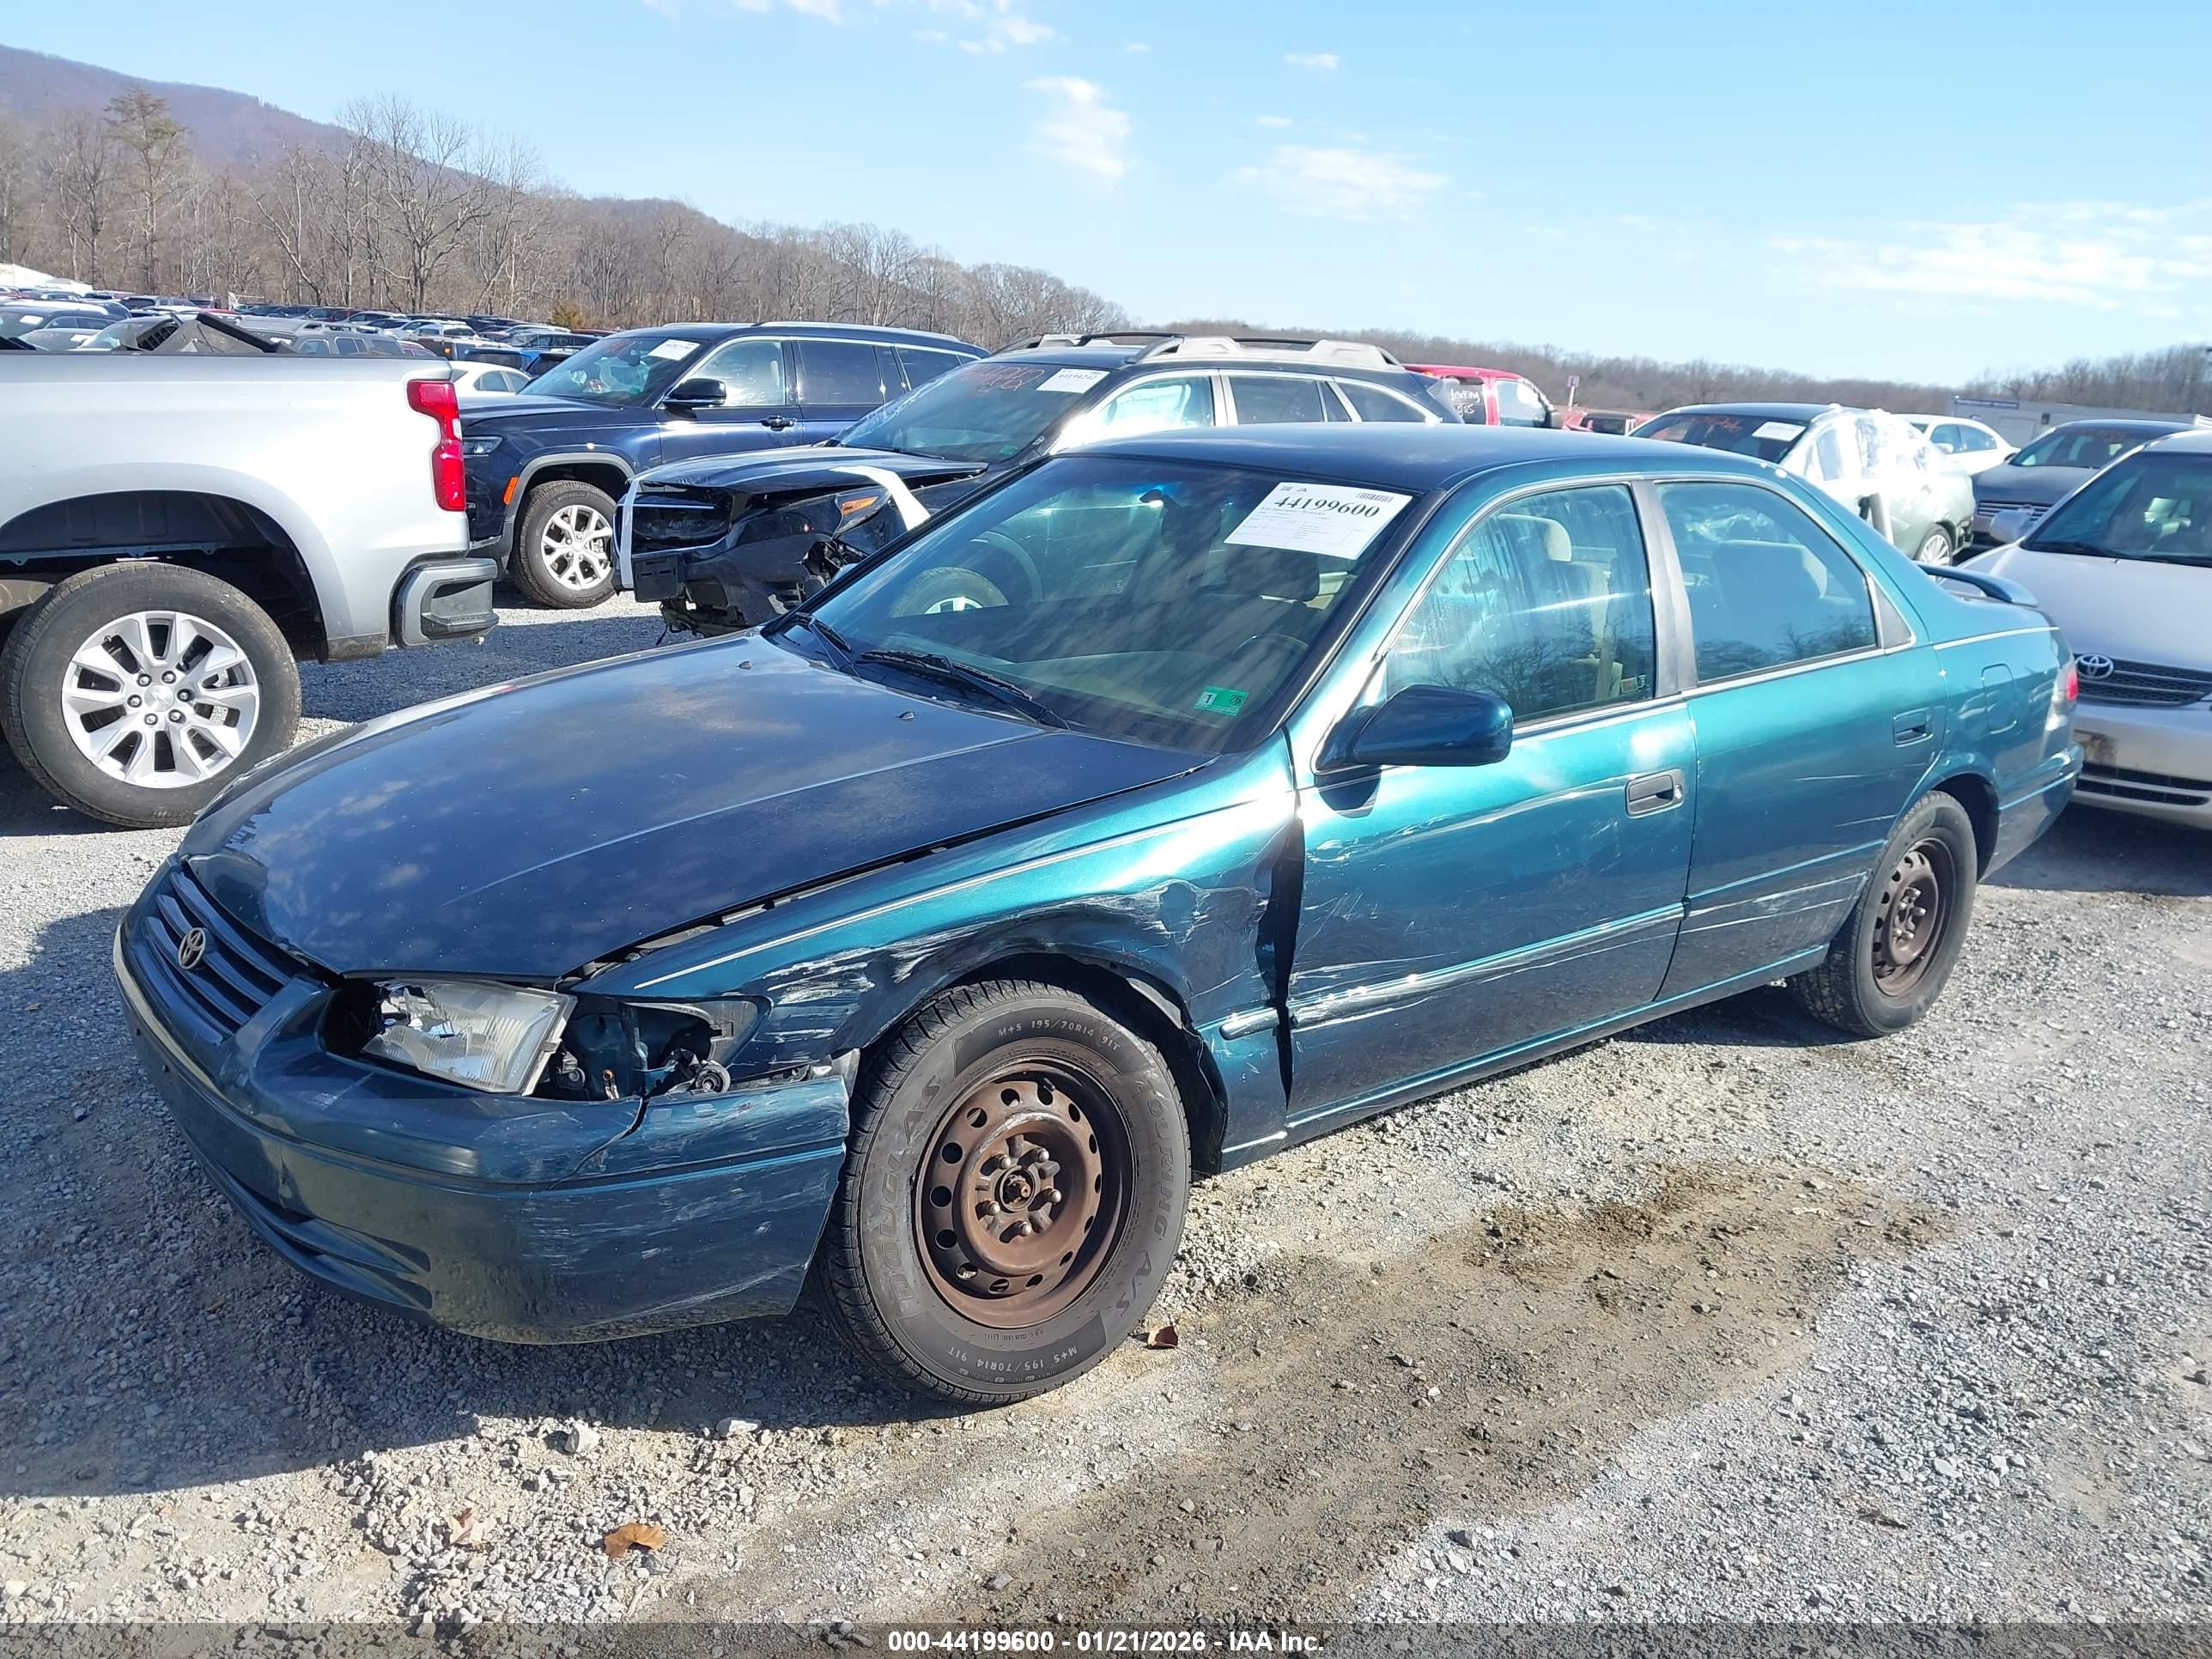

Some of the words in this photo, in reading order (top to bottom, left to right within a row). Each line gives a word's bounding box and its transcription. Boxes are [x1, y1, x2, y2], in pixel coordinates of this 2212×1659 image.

[1274, 496, 1380, 517] 44199600
[998, 1023, 1022, 1037] M+S
[1031, 1018, 1094, 1036] 195/70R14
[1102, 1036, 1121, 1051] 91T
[947, 1346, 968, 1362] 91T
[1054, 1346, 1078, 1364] M+S
[976, 1358, 1044, 1374] 195/70R14
